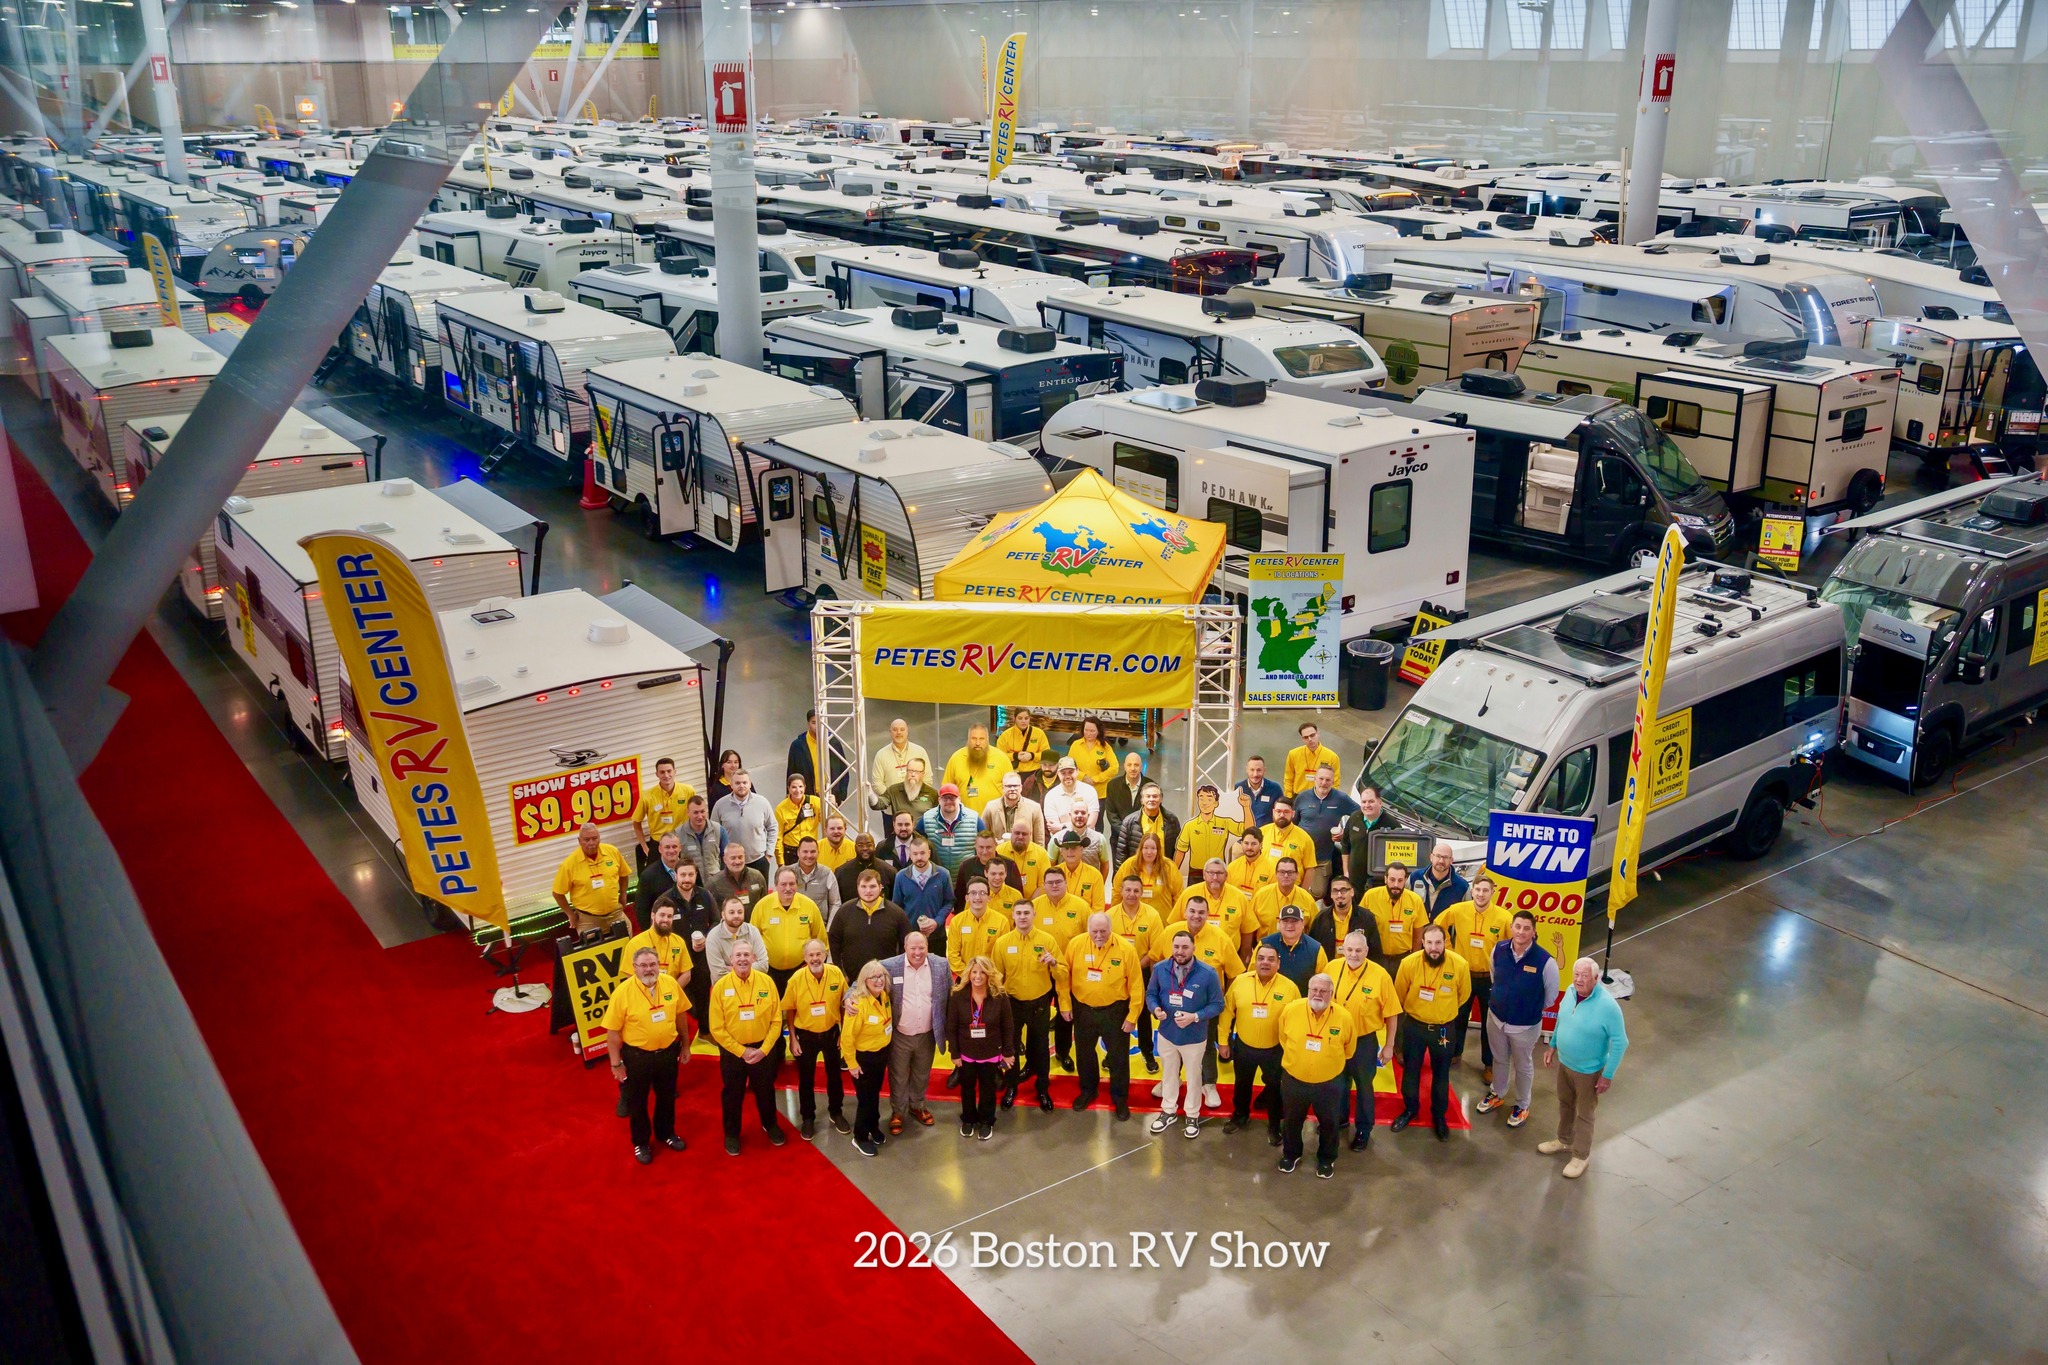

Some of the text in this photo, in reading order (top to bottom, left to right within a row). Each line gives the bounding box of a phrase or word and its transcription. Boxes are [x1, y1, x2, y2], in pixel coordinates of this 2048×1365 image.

[580, 249, 608, 257] Jayco
[1831, 298, 1859, 308] FOREST
[1476, 323, 1494, 331] FOREST
[1039, 375, 1089, 388] ENTEGRA
[1843, 392, 1862, 400] FOREST
[1388, 462, 1429, 477] Jayco
[773, 482, 790, 496] 23
[1201, 480, 1268, 510] REDHAWK
[1005, 546, 1144, 570] PETE'S RV CENTER
[1302, 558, 1339, 566] CENTER
[867, 567, 882, 580] FREE
[1872, 623, 1899, 637] Jayco
[1409, 649, 1435, 665] TODAY!
[1248, 693, 1336, 701] SALES SERVICE PARTS
[1032, 706, 1129, 721] ARDINAL
[336, 553, 478, 897] PETES RV CENTER
[1662, 721, 1681, 733] CREDIT
[1654, 727, 1689, 746] CHALLENGES?
[513, 762, 636, 800] SHOW SPECIAL
[1656, 770, 1683, 786] WE'VE GOT
[1653, 780, 1684, 797] SOLUTIONS!
[520, 780, 633, 838] $9,999
[1503, 822, 1580, 844] ENTER TO
[1493, 840, 1586, 873] WIN
[1547, 916, 1576, 926] CARD
[573, 947, 622, 988] RV
